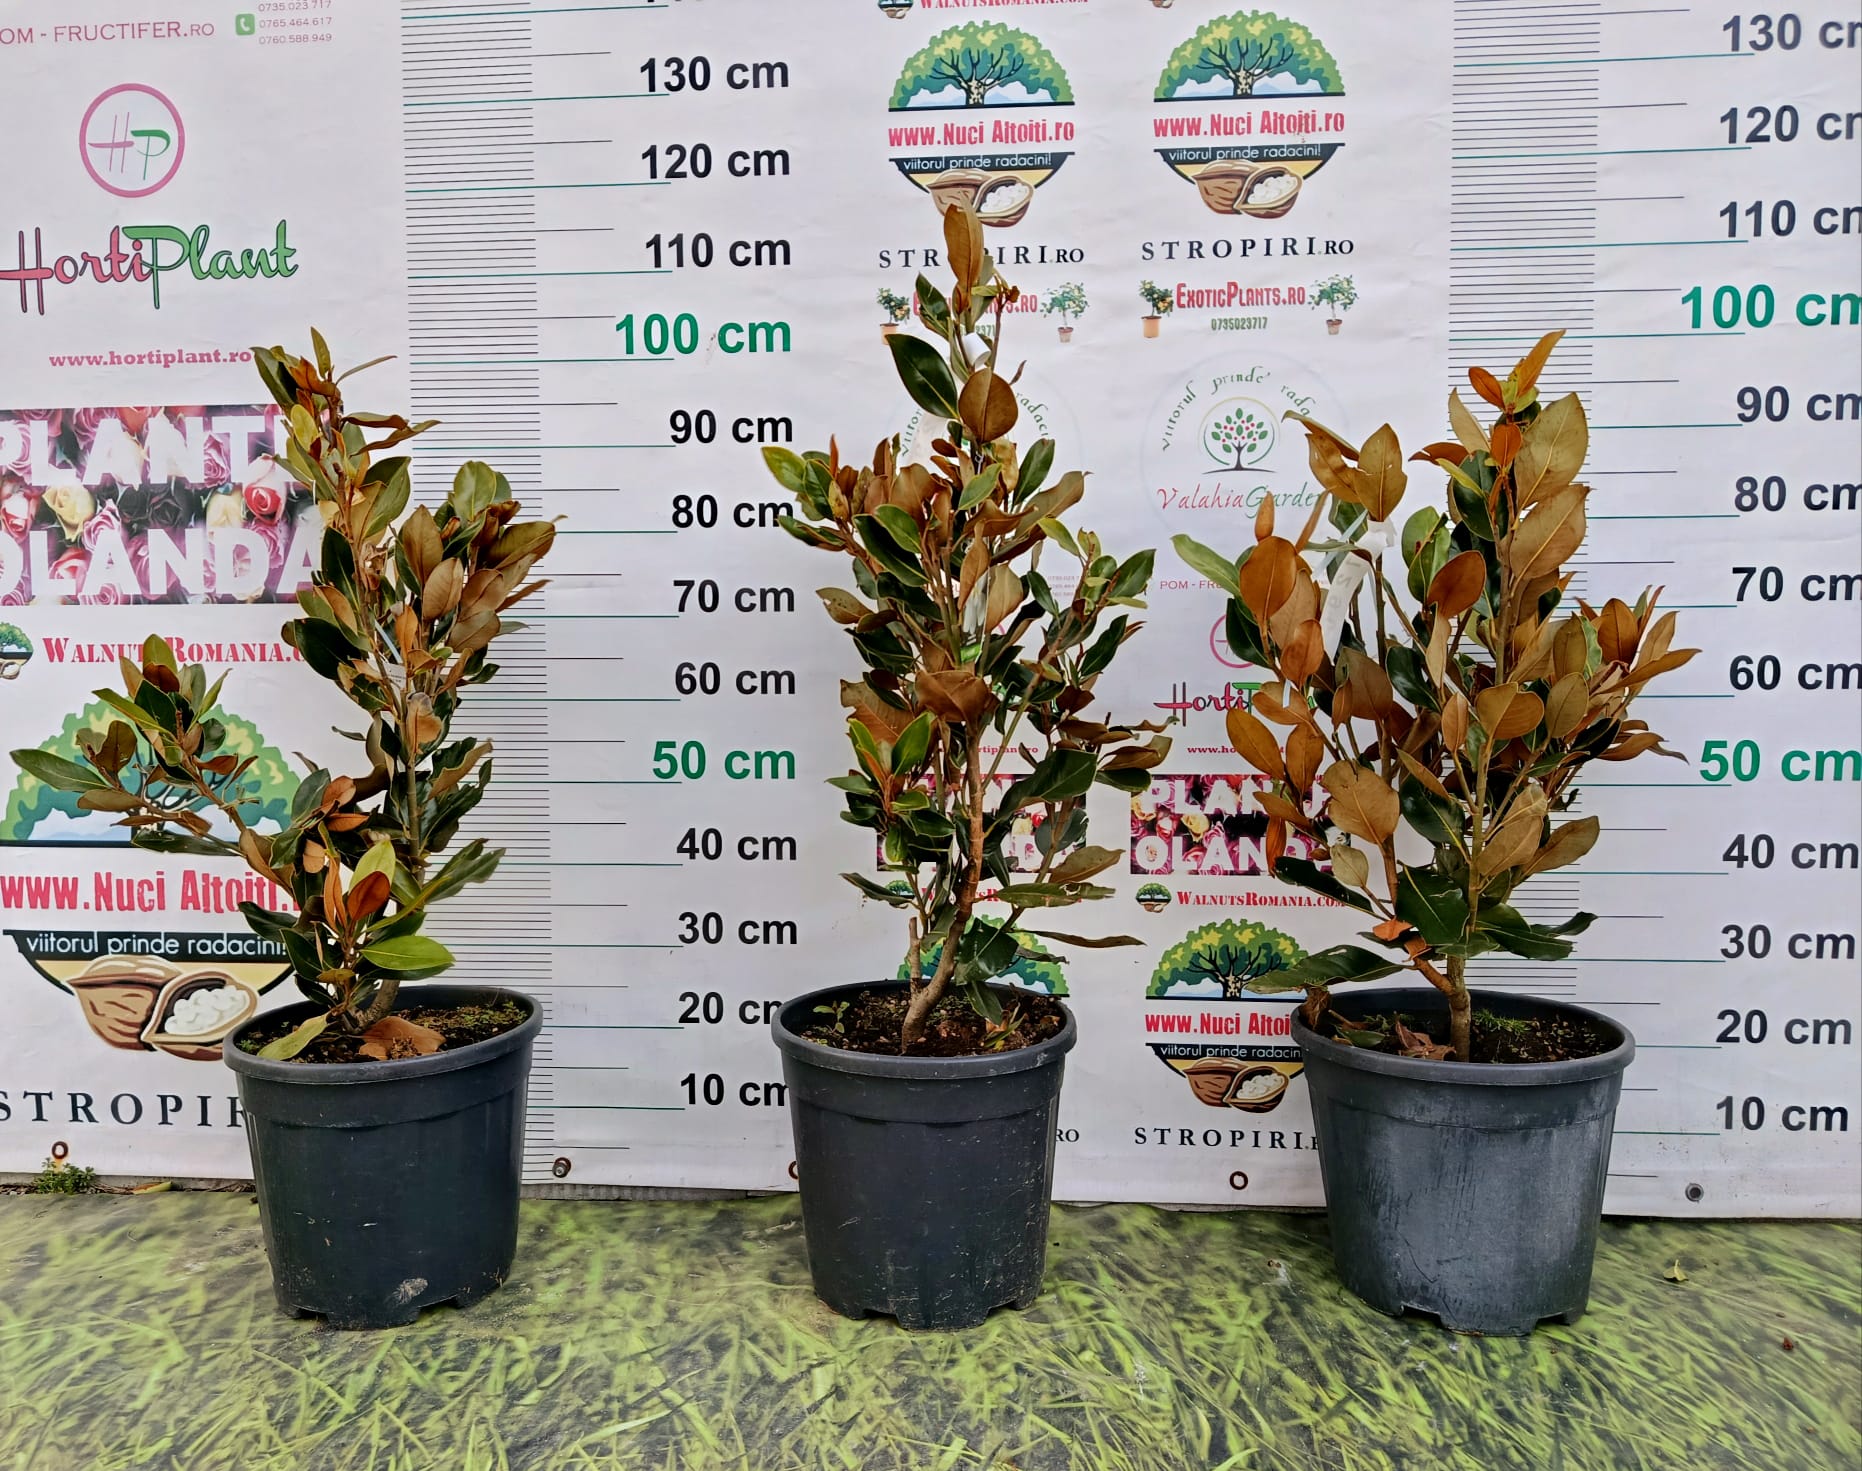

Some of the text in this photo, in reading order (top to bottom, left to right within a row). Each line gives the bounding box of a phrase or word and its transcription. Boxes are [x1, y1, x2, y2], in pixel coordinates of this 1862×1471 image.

[54, 21, 215, 42] FRUCTIFER.RO
[1723, 14, 1801, 51] 130
[641, 56, 788, 92] 130 cm
[888, 119, 1075, 147] www.Nuci Altoiti.ro
[1153, 112, 1252, 137] www.Nuci
[1721, 105, 1798, 143] 120
[642, 144, 789, 179] 120 cm
[903, 153, 1052, 170] viitorul prinde radacini!
[1169, 144, 1321, 161] viitorul prinde radacini!
[1720, 200, 1795, 237] 110
[646, 233, 790, 268] 110 cm
[879, 246, 1084, 268] STRIRI.RO
[1141, 237, 1355, 261] STROPIRI.RO
[0, 220, 299, 316] HortiPlant
[1682, 285, 1774, 328] 100
[615, 313, 790, 354] 100 cm
[49, 348, 252, 369] www.hortiplant.ro
[1737, 386, 1789, 422] 90
[670, 410, 793, 443] 90 cm
[1735, 476, 1862, 512] 80 cm
[672, 495, 794, 528] 80 cm
[674, 580, 794, 612] 70 cm
[1160, 580, 1188, 590] POM
[1733, 567, 1862, 601] 70 cm
[676, 662, 795, 695] 60 cm
[1730, 655, 1862, 690] 60 cm
[653, 741, 795, 779] 50 cm
[1700, 740, 1862, 781] 50 cm
[677, 828, 796, 860] 40 cm
[1723, 834, 1858, 868] 40 cm
[1, 871, 166, 913] www.Nuci
[26, 933, 98, 953] viitorul
[107, 932, 179, 956] prinde
[679, 912, 797, 944] 30 cm
[1721, 925, 1855, 959] 30 cm
[679, 992, 723, 1024] 20
[1145, 1012, 1240, 1035] www.Nuci
[1716, 1010, 1851, 1044] 20 cm
[1161, 1043, 1300, 1059] viitorul prinde radacin
[681, 1073, 724, 1105] 10
[1717, 1096, 1848, 1131] 10 cm
